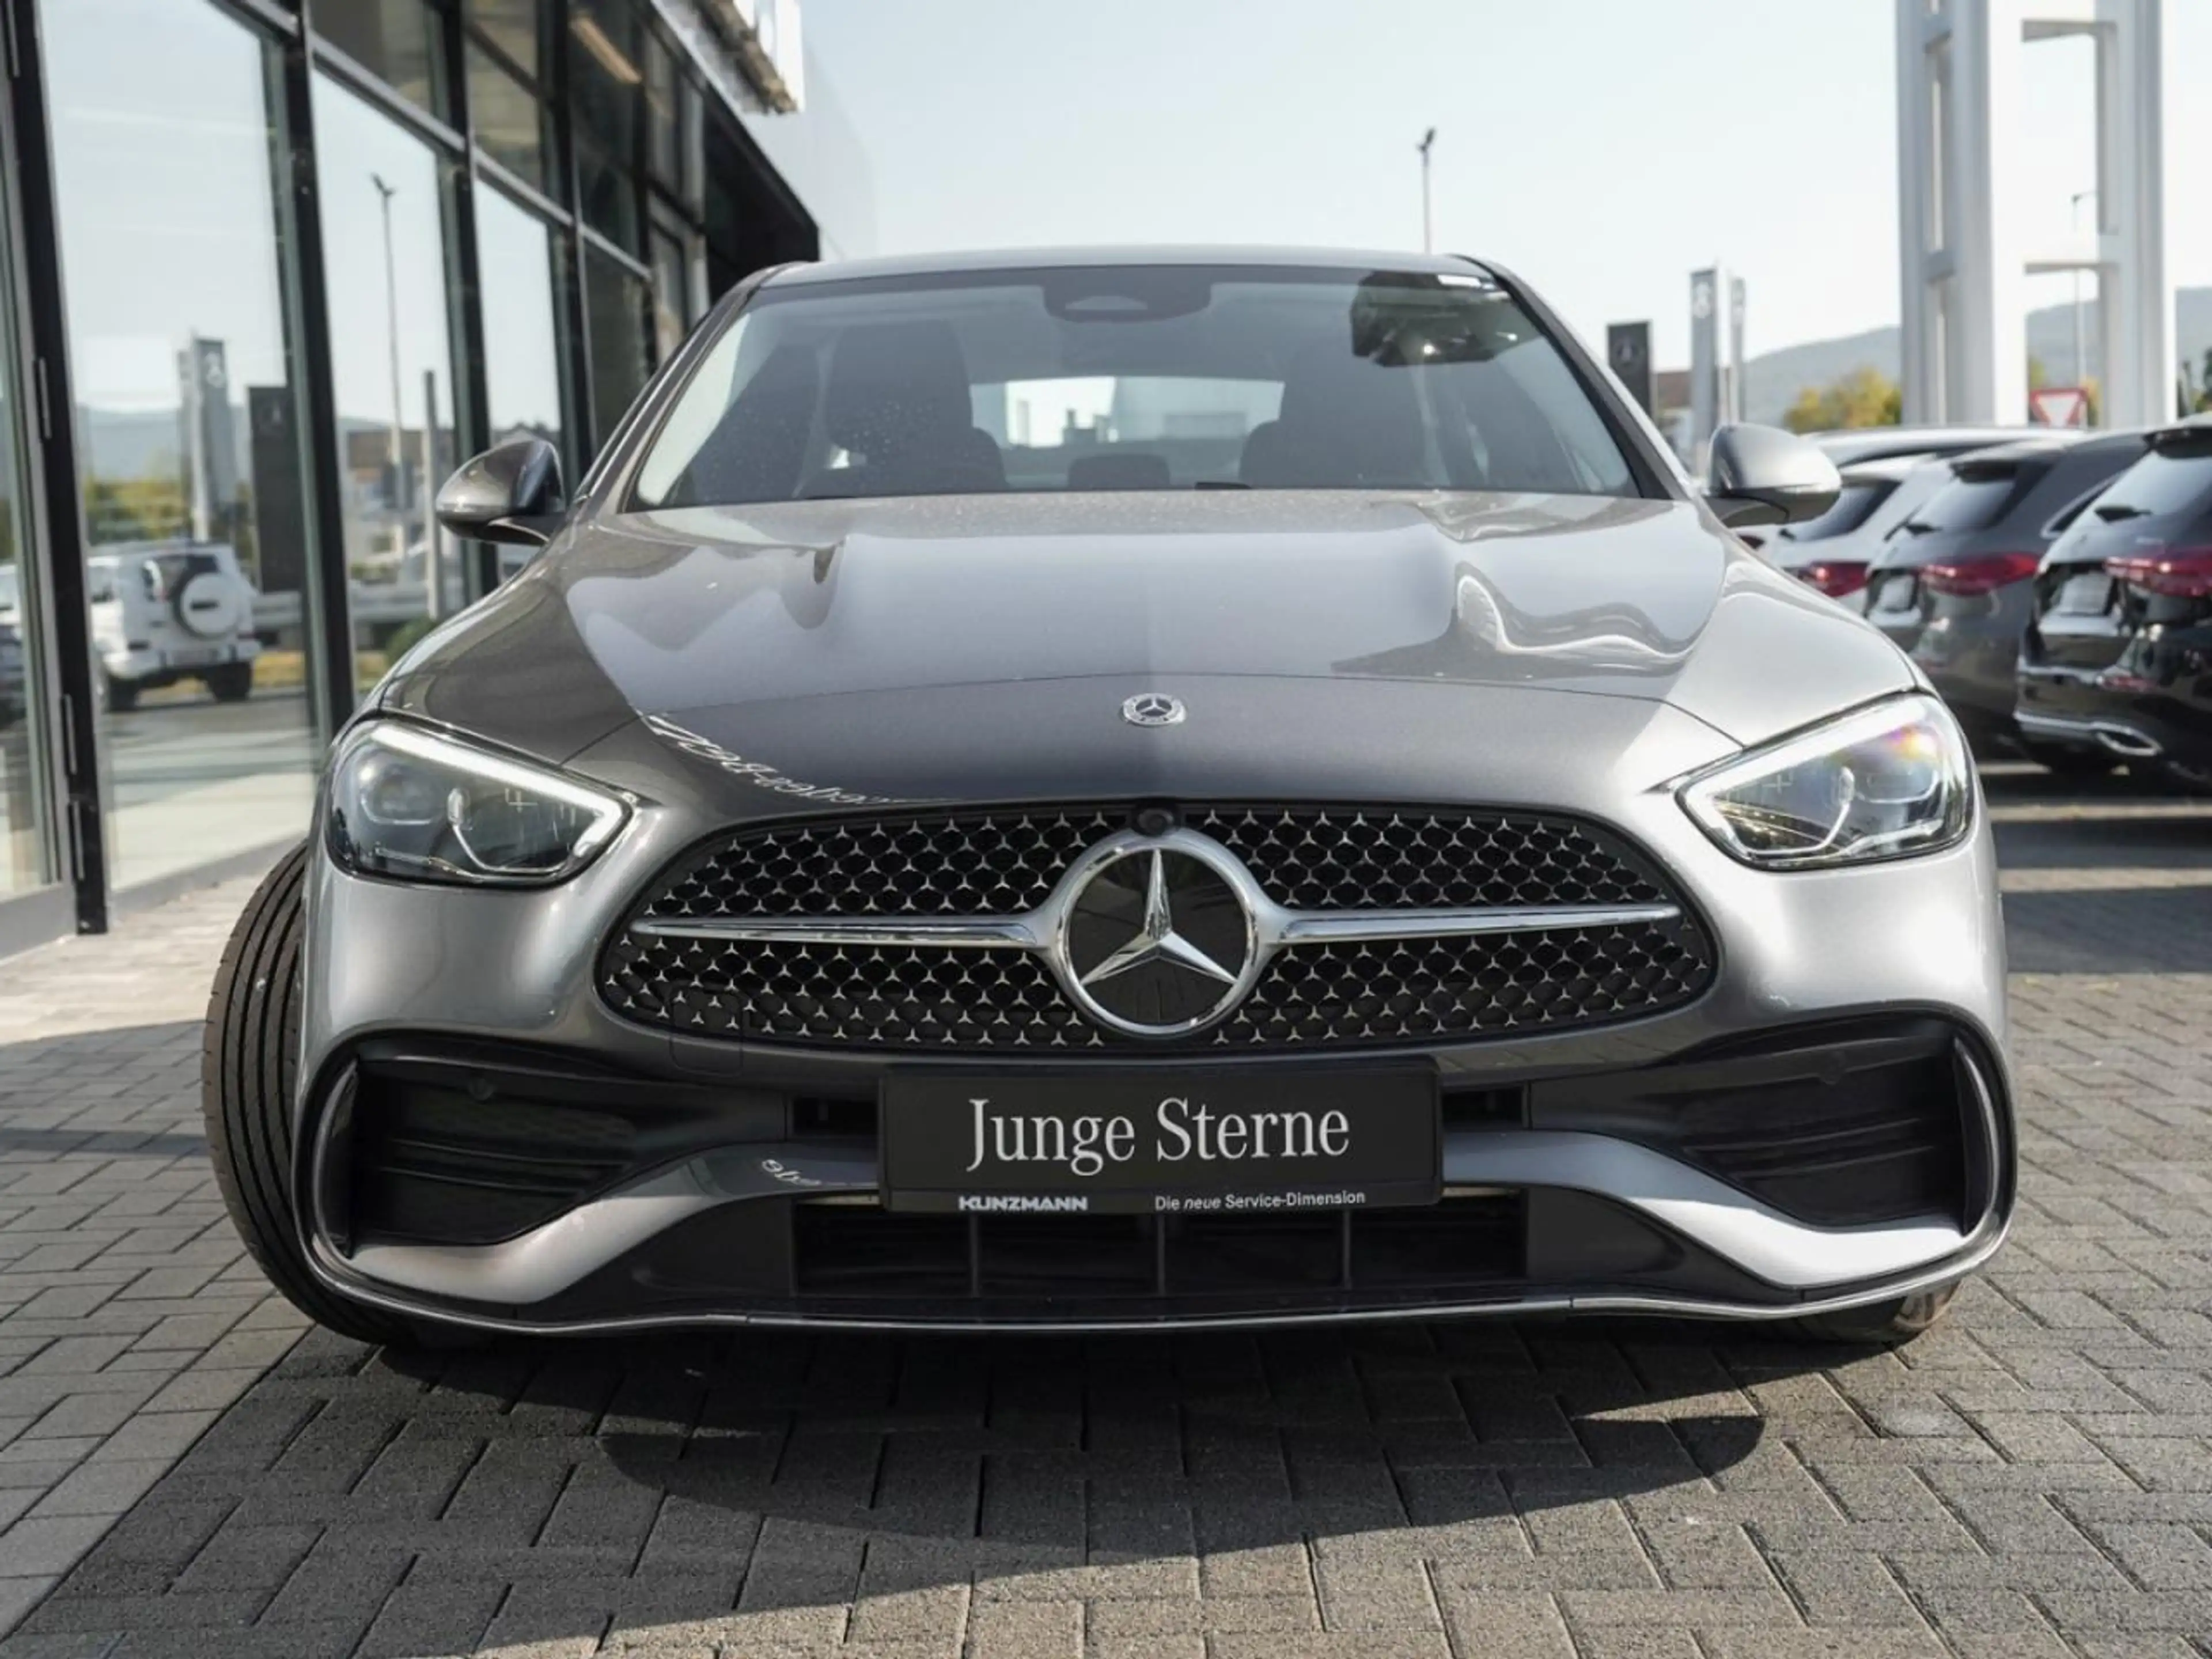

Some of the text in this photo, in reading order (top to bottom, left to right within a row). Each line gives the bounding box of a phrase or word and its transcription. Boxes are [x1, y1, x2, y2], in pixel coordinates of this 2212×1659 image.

[967, 1097, 1349, 1176] Junge Sterne
[958, 1195, 1088, 1211] KUNZMANN
[1154, 1190, 1366, 1211] Die neue Service-Dimension
